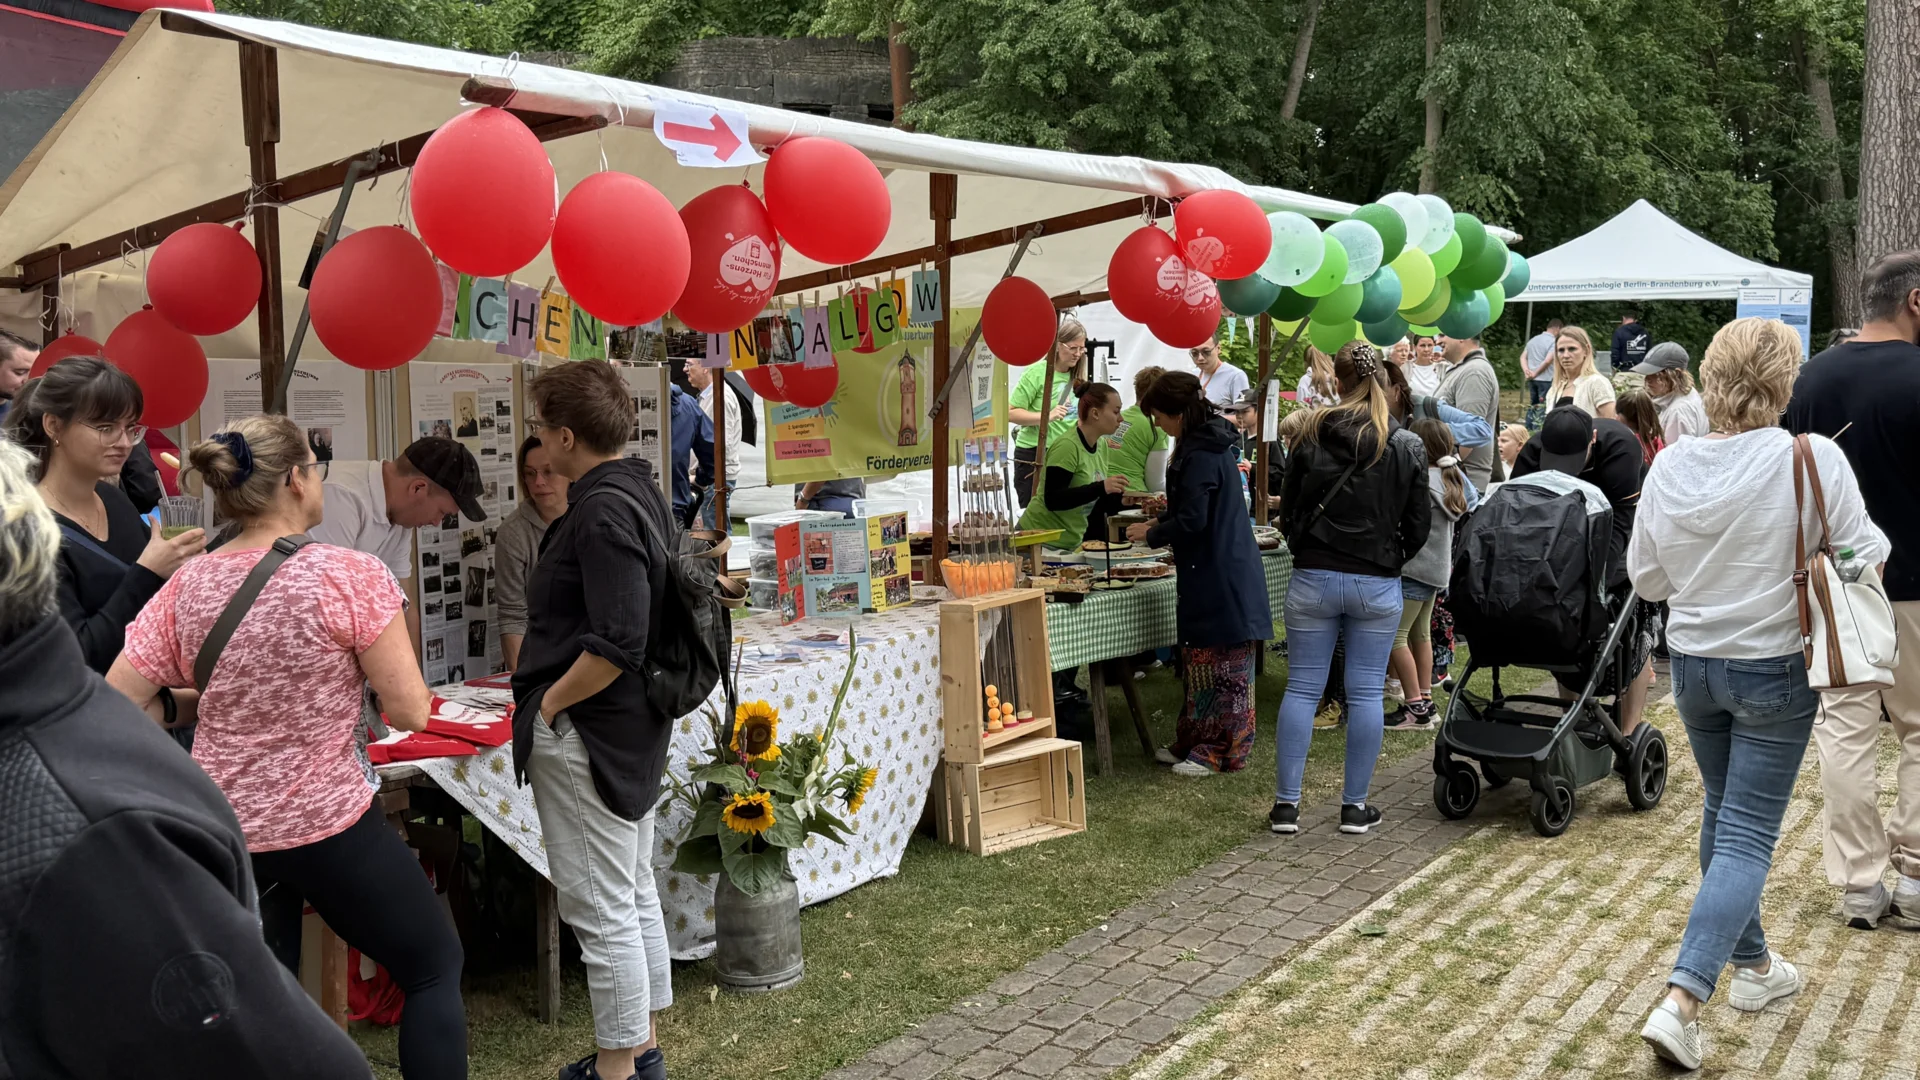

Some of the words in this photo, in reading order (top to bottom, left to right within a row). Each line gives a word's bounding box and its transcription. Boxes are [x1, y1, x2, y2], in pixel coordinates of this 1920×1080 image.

[725, 263, 762, 279] Herzens-
[1528, 281, 1621, 291] Unterwasserarchäologie
[1623, 280, 1703, 289] Berlin-Brandenburg
[1705, 280, 1721, 288] e.V.
[456, 291, 597, 346] CHEN
[866, 454, 933, 471] Förderverei
